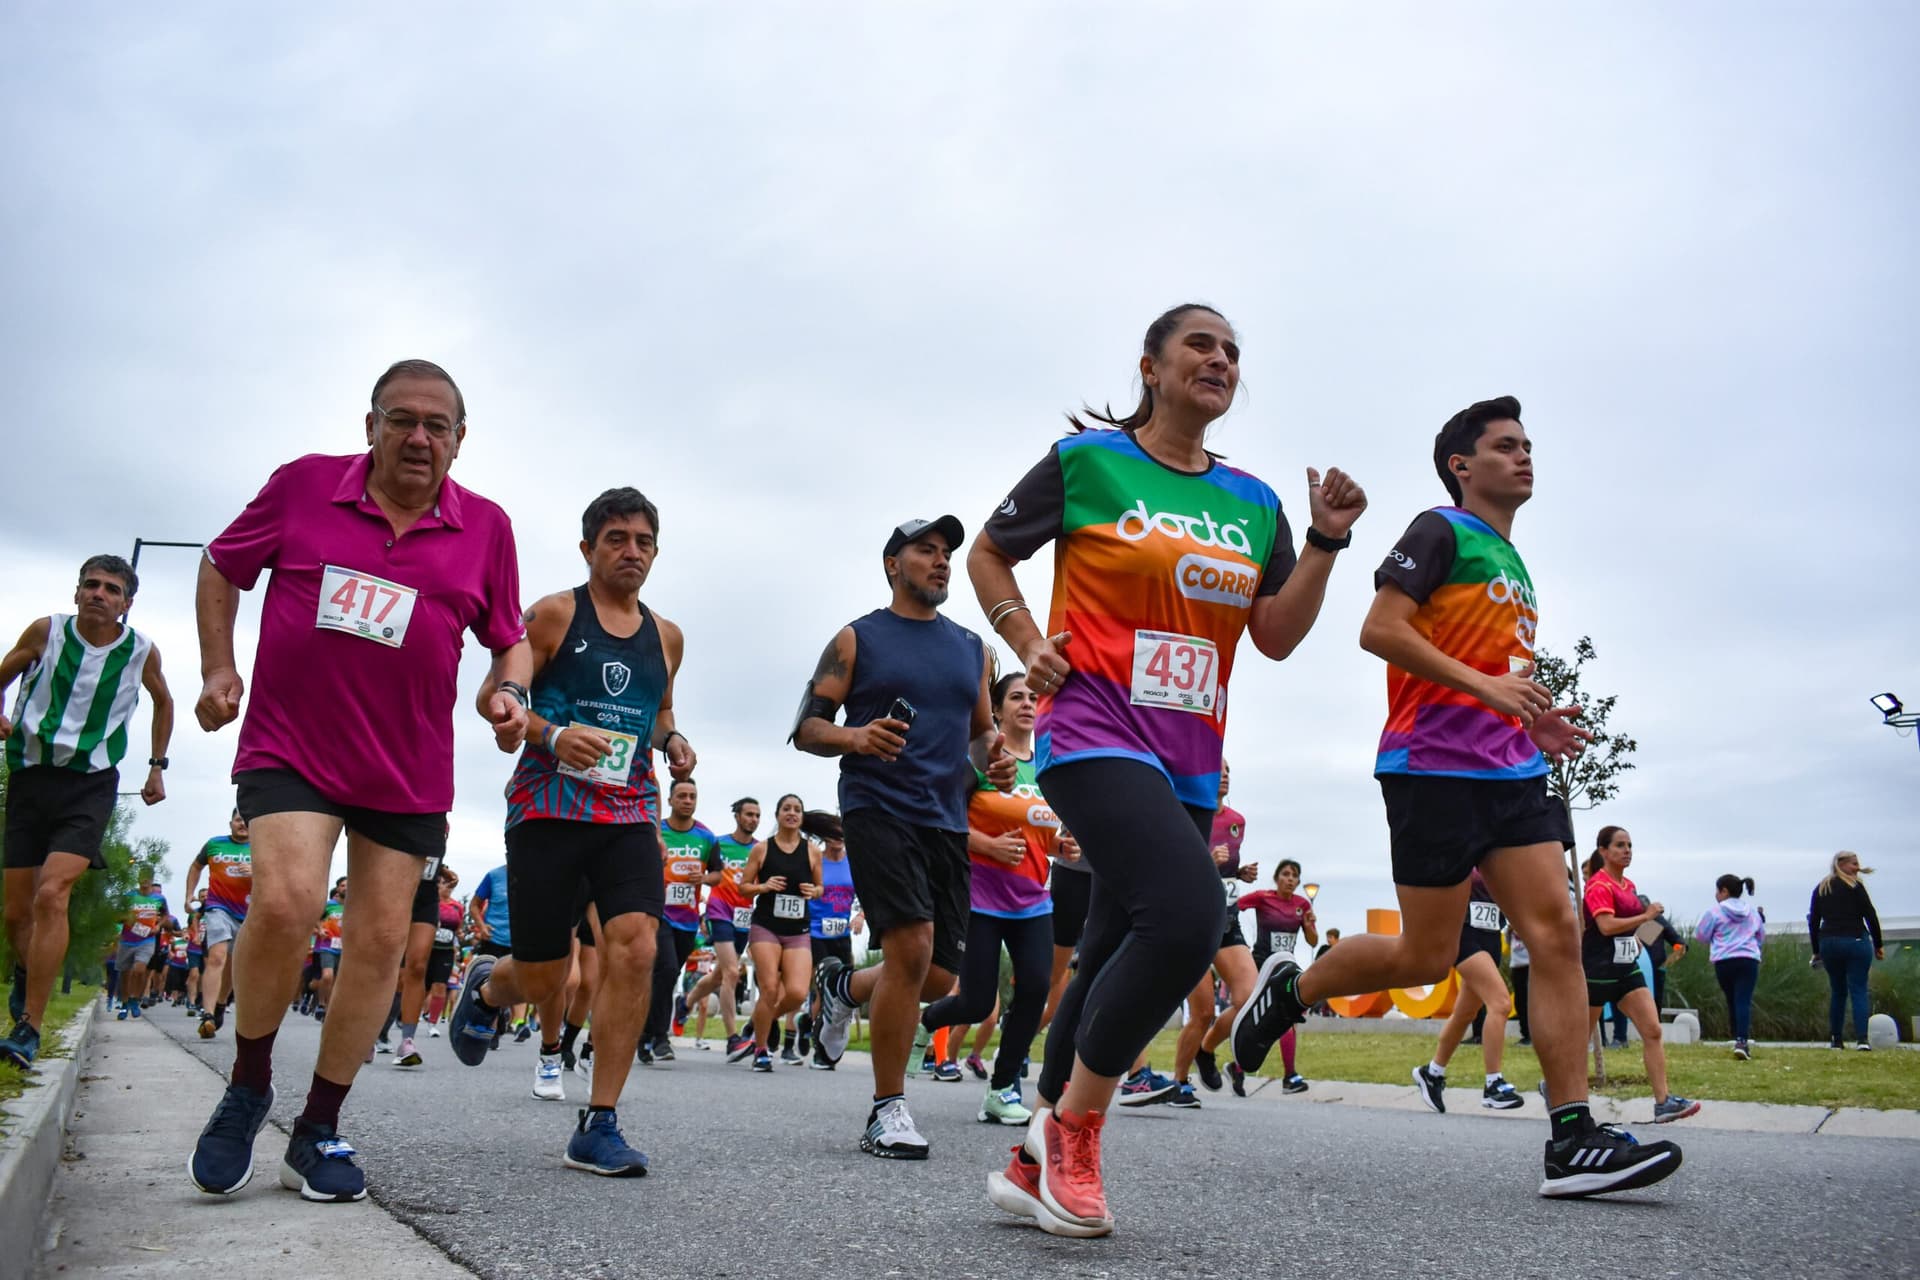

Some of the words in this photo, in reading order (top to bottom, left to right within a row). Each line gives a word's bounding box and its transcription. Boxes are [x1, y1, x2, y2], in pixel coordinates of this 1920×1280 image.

[330, 578, 402, 624] 417
[1145, 642, 1214, 693] 437
[672, 886, 692, 899] 197
[780, 898, 800, 912] 115
[737, 910, 753, 923] 28
[1475, 905, 1496, 922] 276
[1275, 935, 1295, 947] 337
